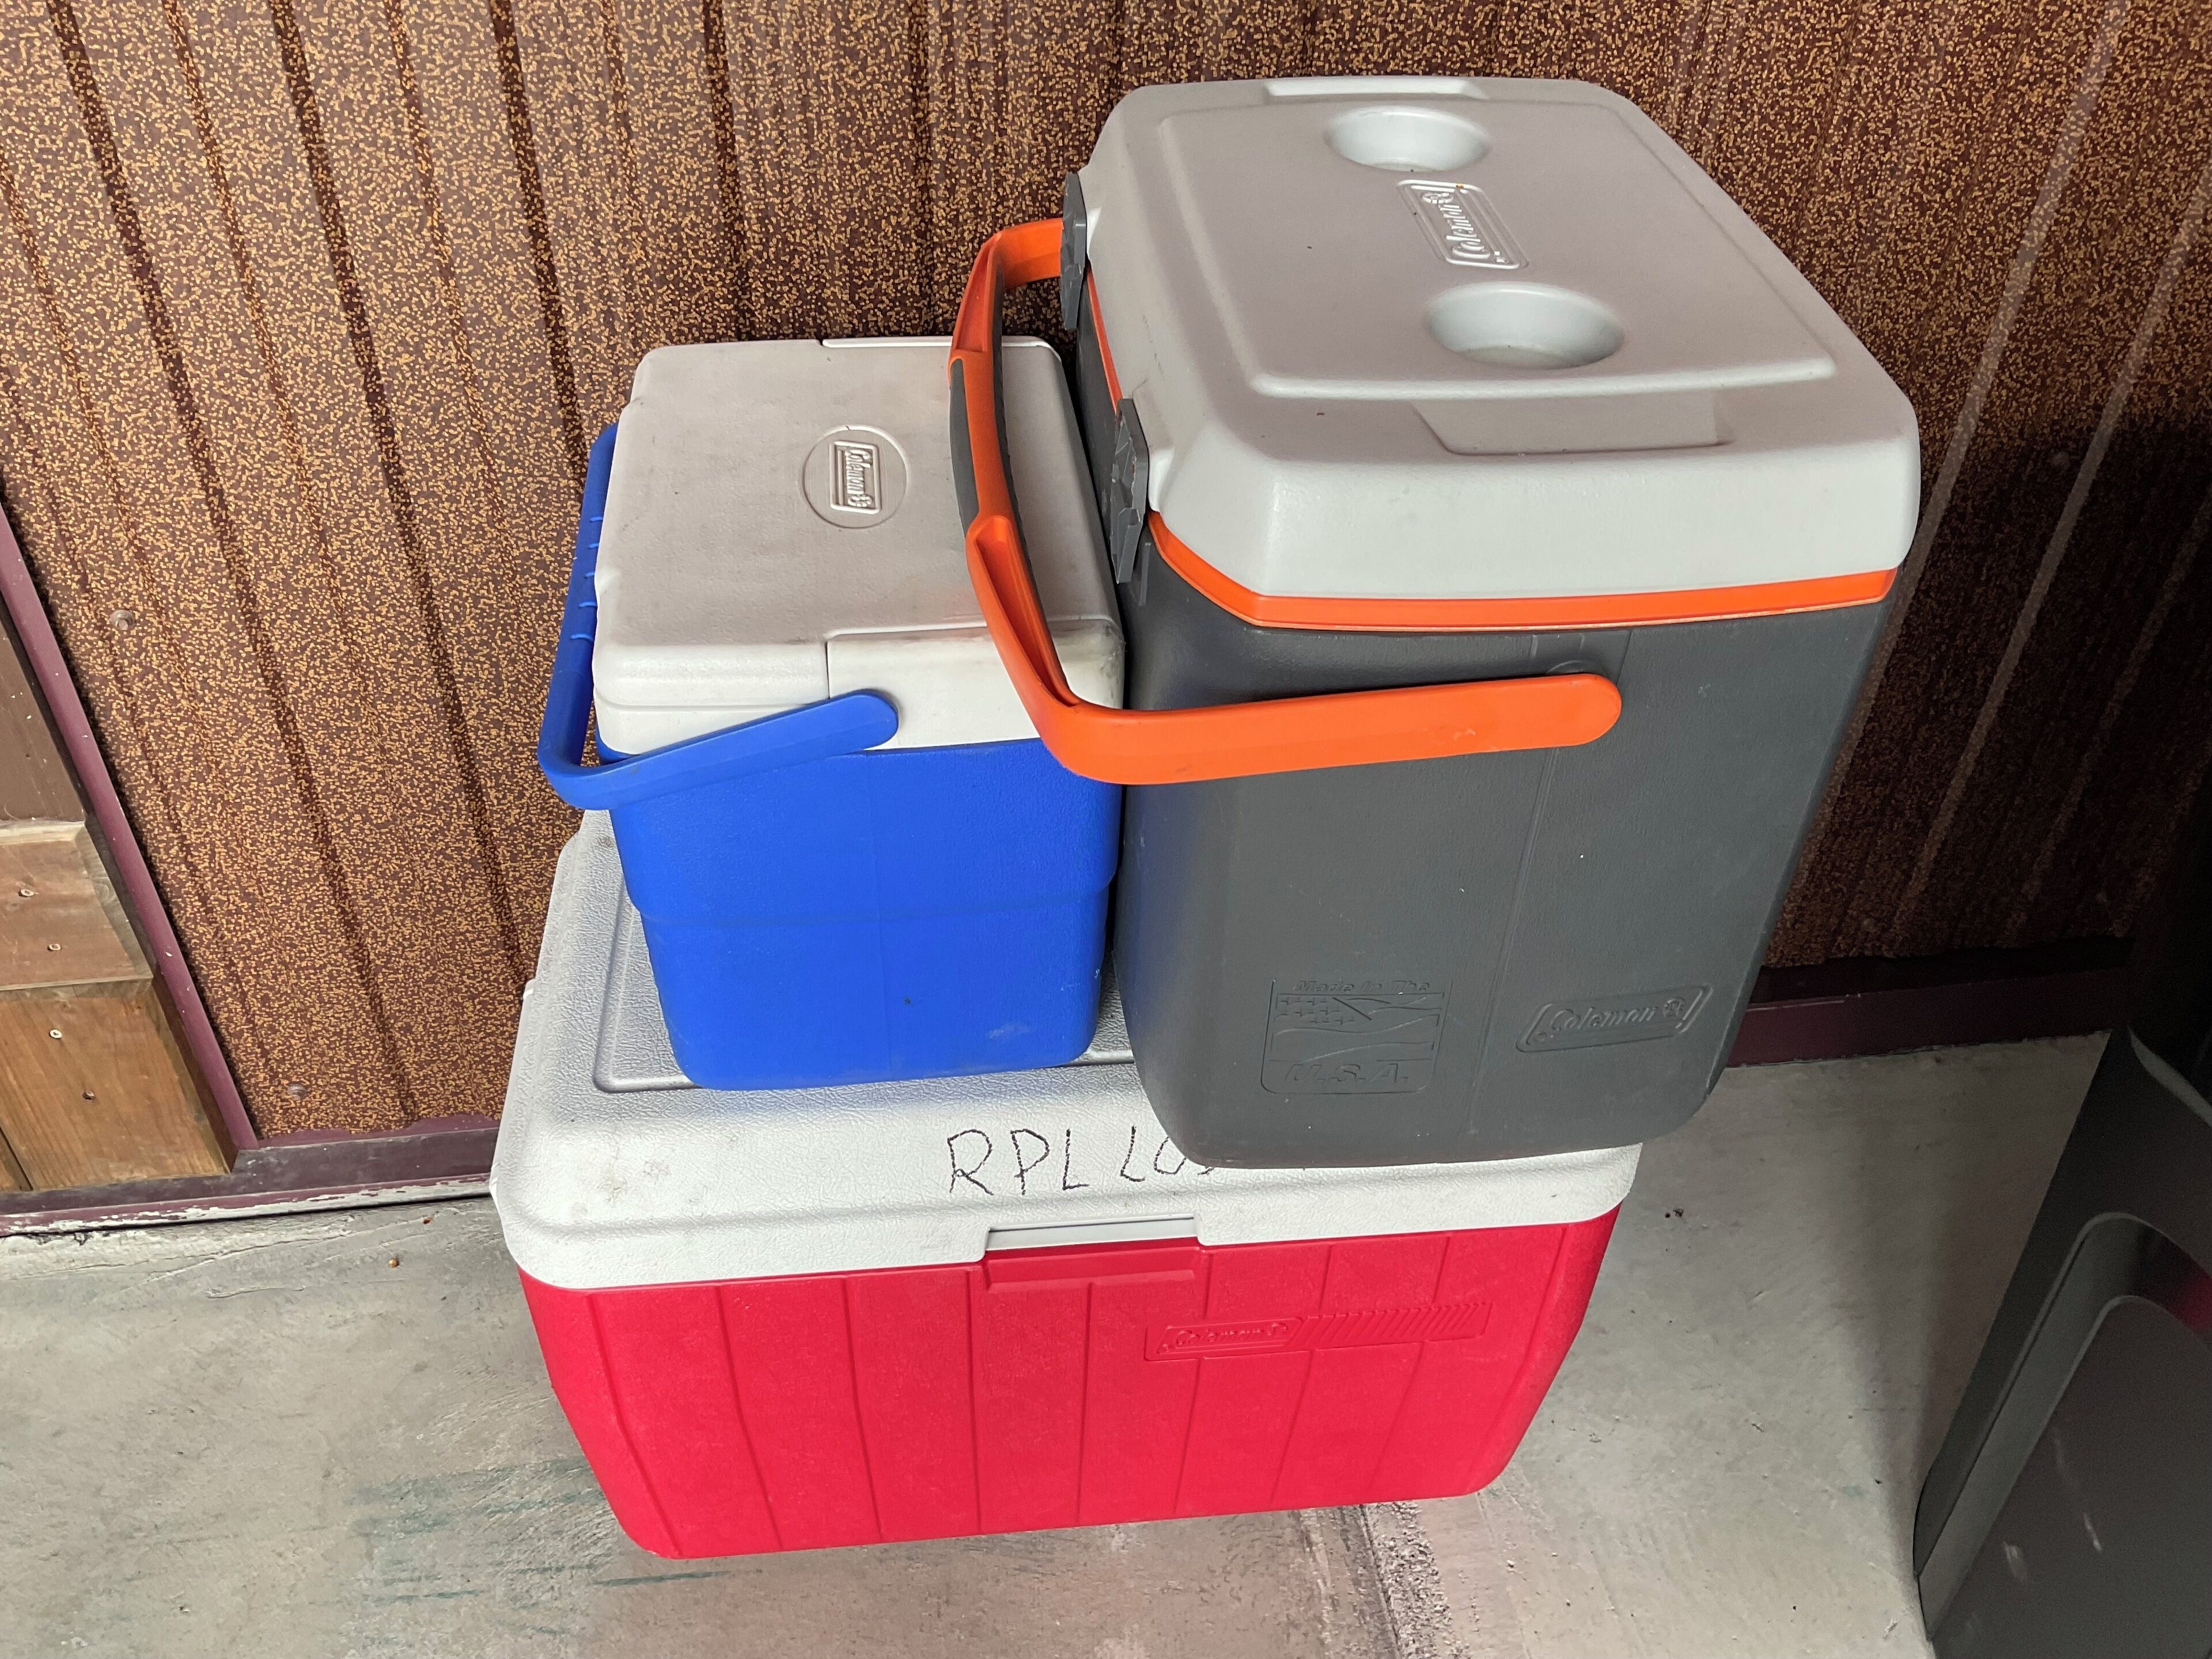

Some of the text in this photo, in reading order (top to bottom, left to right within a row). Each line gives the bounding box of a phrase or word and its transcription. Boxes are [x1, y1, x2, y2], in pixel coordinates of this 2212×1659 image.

[1439, 204, 1491, 259] Coleman
[844, 449, 872, 494] Coleman
[1295, 980, 1354, 991] Made
[1389, 980, 1430, 991] The
[1550, 1007, 1657, 1031] Coleman
[1175, 1328, 1264, 1344] Coleman
